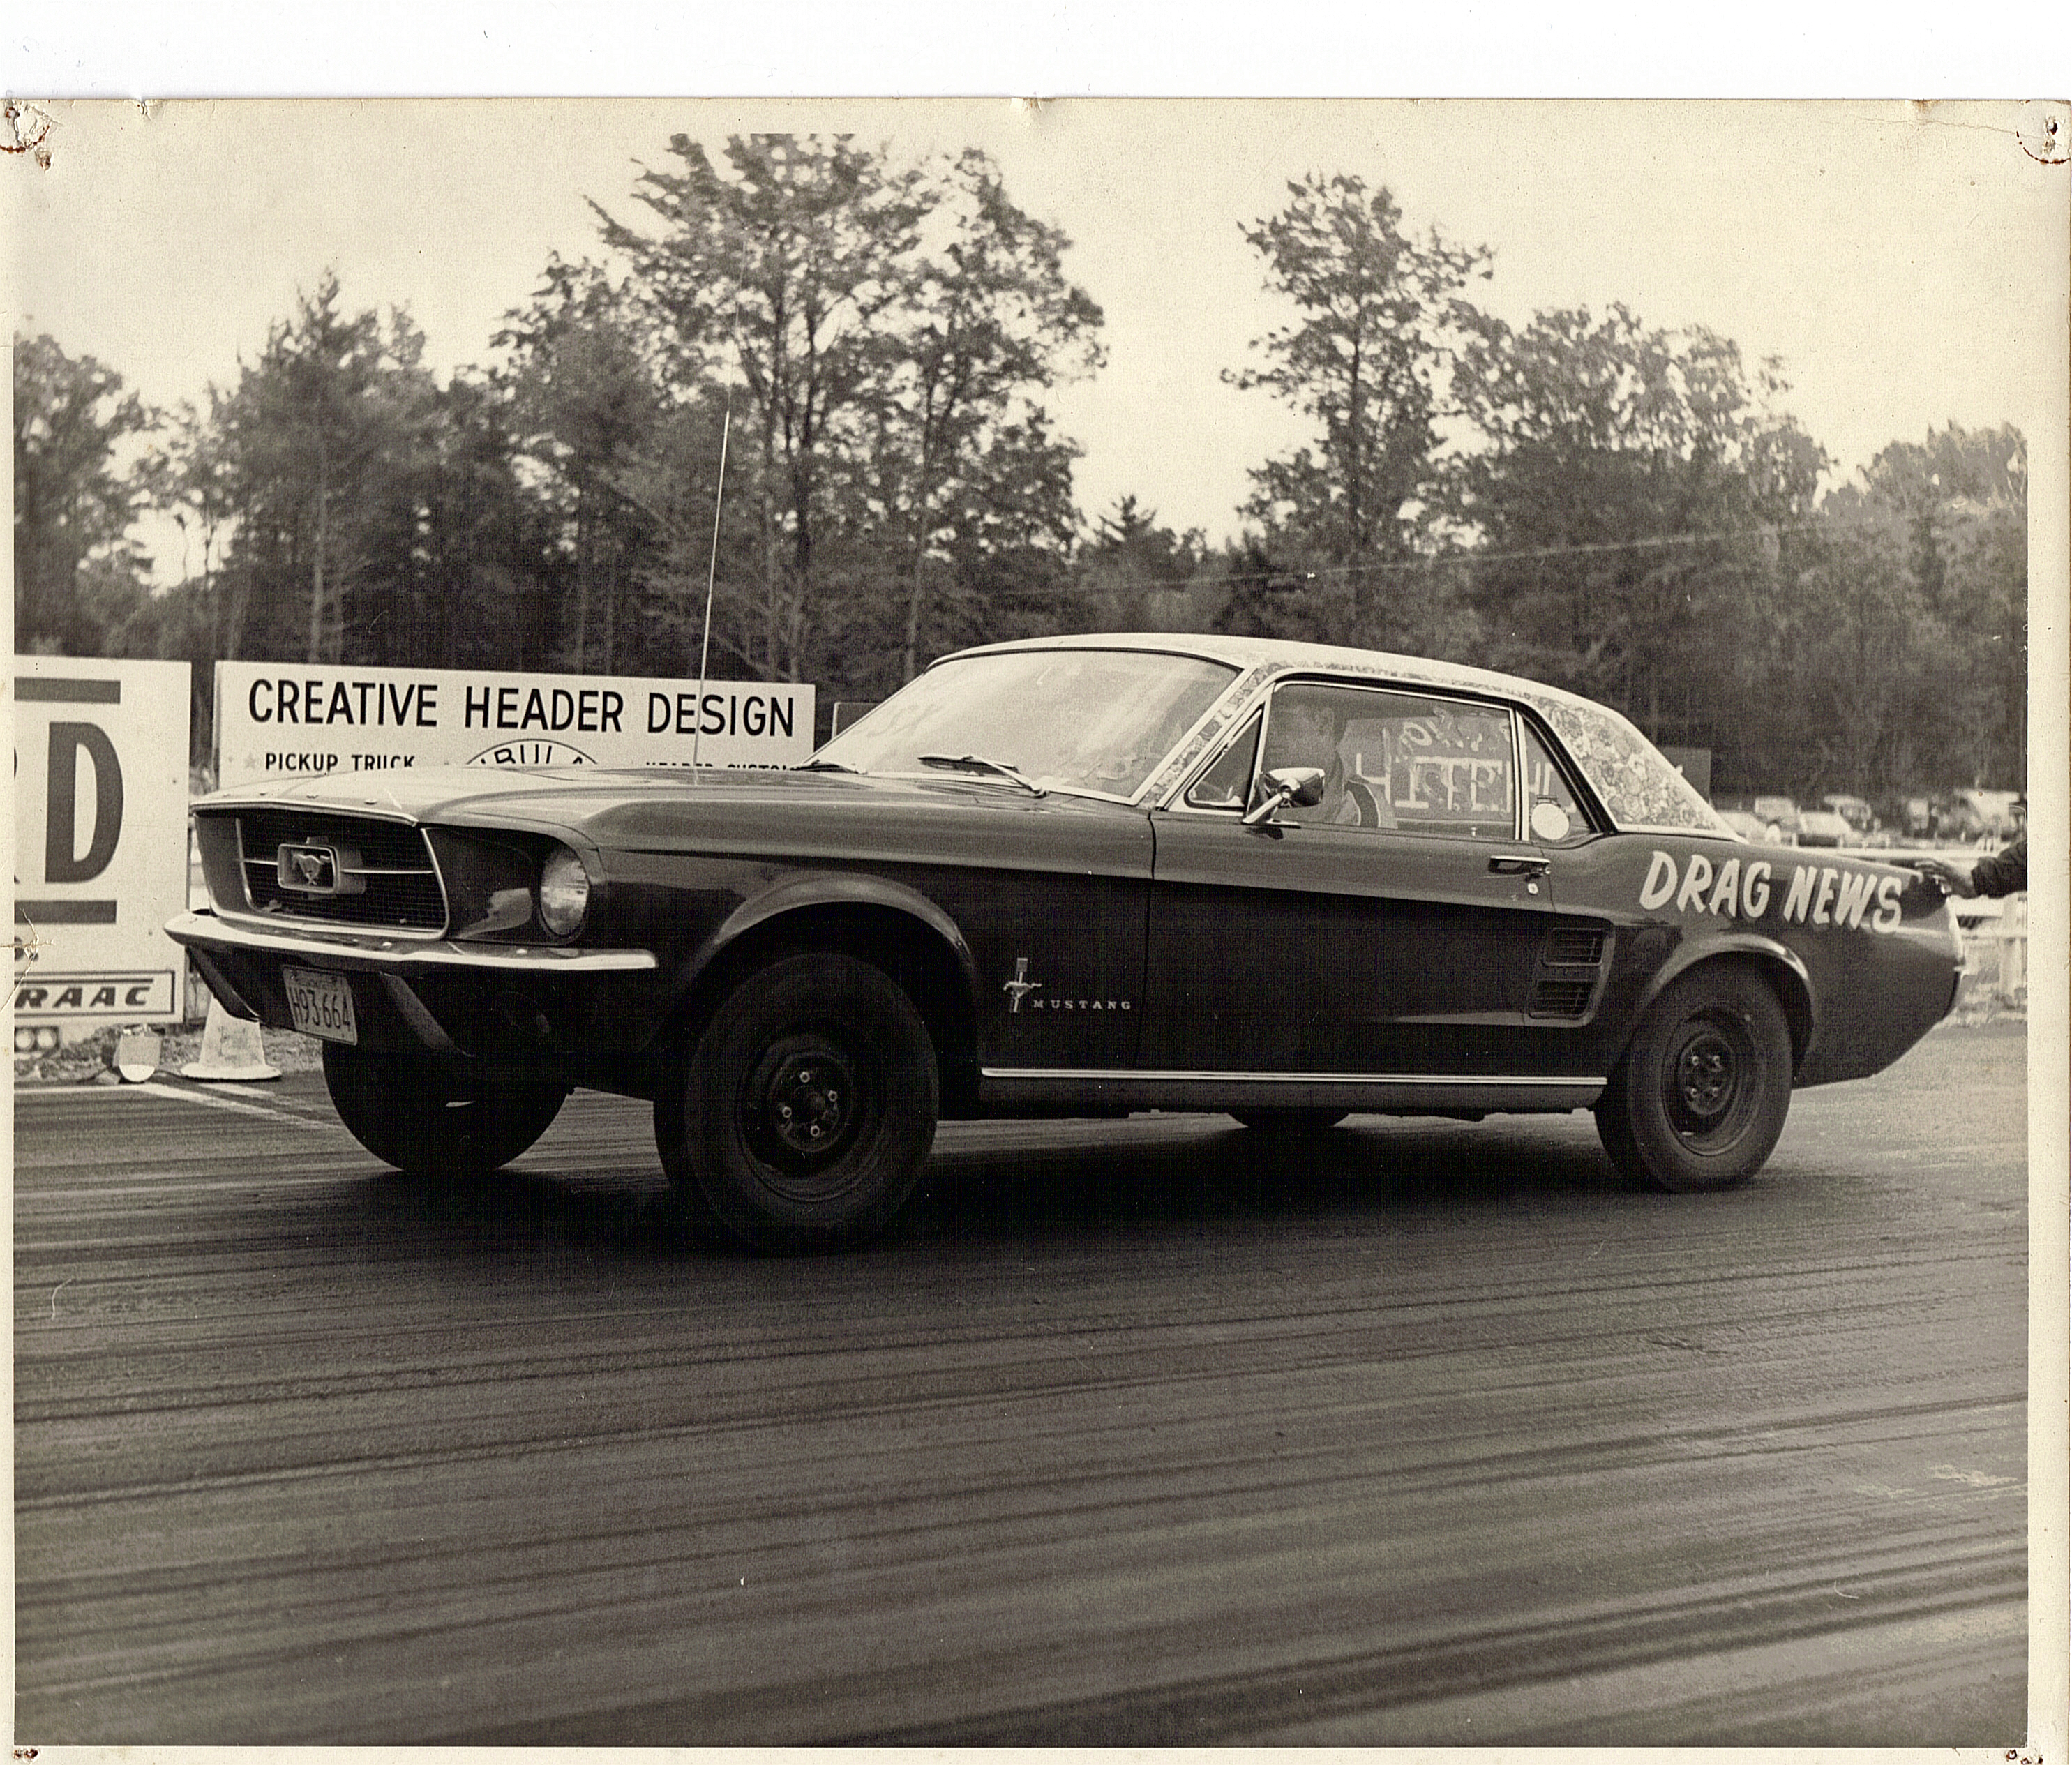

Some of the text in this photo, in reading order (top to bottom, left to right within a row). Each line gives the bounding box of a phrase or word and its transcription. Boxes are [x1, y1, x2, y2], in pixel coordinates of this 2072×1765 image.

[248, 679, 794, 737] CREATIVE HEADER DESIGN
[265, 753, 416, 772] PICKUP TRUCK
[1639, 850, 1902, 933] DRAG NEWS
[1033, 1000, 1131, 1010] MUSTANG
